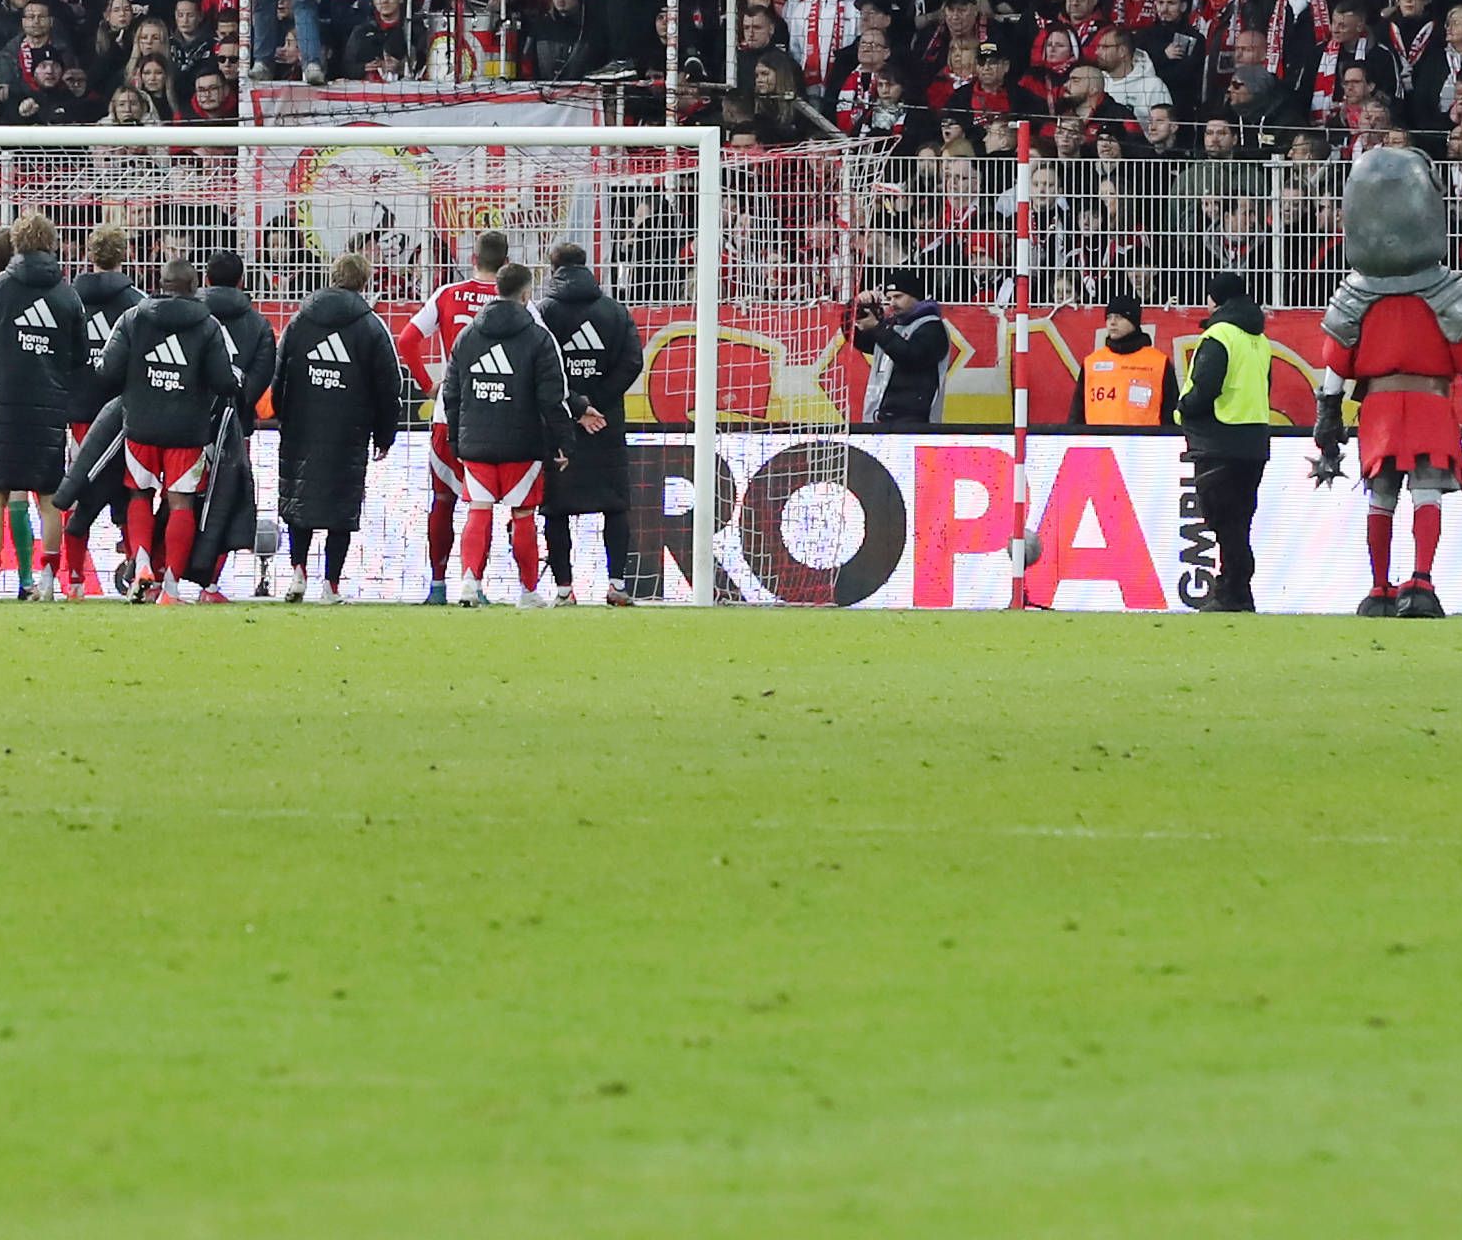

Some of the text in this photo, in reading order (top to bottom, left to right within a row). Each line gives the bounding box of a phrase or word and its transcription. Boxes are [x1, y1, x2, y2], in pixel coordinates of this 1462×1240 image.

[18, 331, 50, 344] home
[566, 357, 597, 368] home
[147, 366, 181, 380] home
[308, 365, 341, 378] home
[472, 378, 505, 391] home
